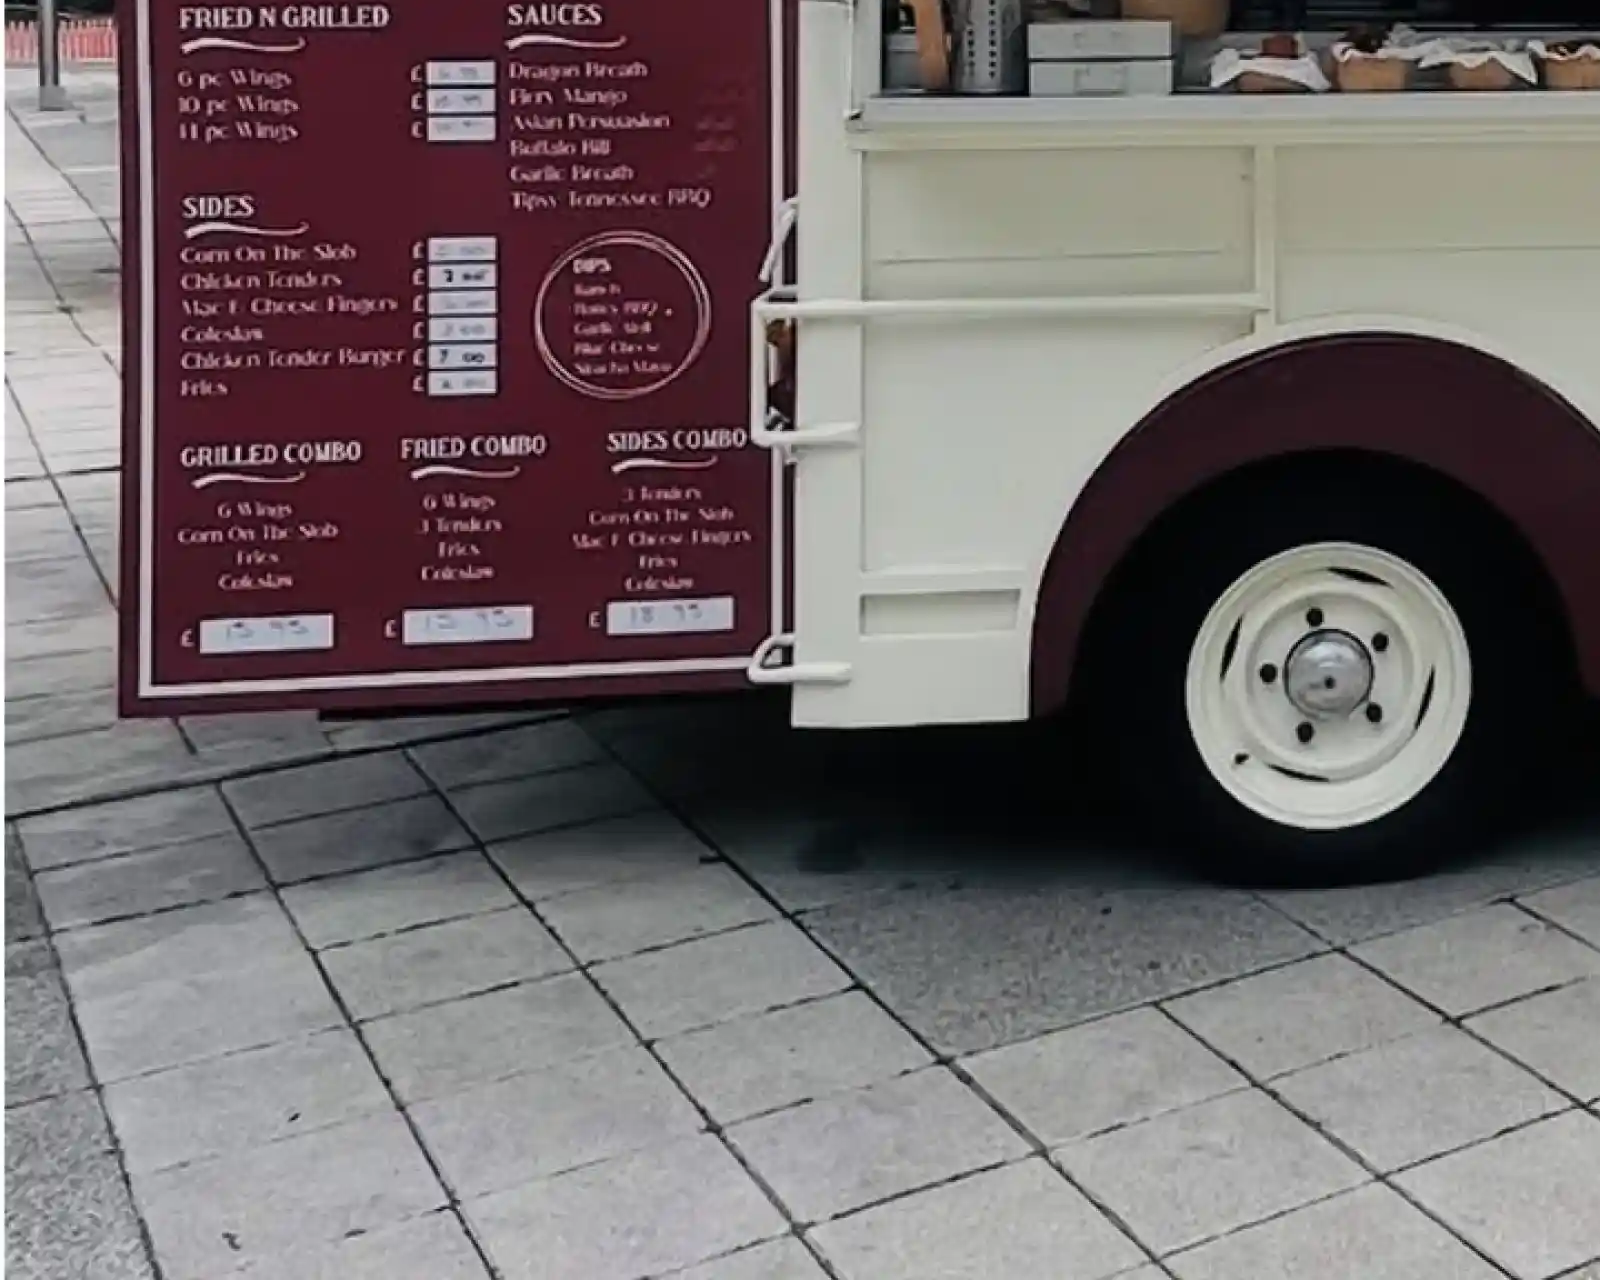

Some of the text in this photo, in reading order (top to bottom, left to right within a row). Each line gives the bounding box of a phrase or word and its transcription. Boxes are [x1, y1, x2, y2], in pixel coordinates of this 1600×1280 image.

[180, 6, 389, 29] FRIED N GRILLED
[509, 4, 602, 25] SAUCES
[231, 69, 291, 89] Wings
[509, 62, 647, 81] Dragon Breath
[238, 96, 298, 114] Wings
[564, 89, 627, 106] Mango
[236, 122, 298, 140] Wings
[572, 166, 633, 180] Breath
[184, 196, 253, 218] SIDES
[180, 248, 229, 262] Corn
[235, 247, 265, 260] On
[275, 246, 301, 260] The
[181, 271, 342, 289] Chicken Tenders
[181, 326, 262, 341] Coleslaw
[182, 349, 404, 369] Chicken Tender Burger
[182, 380, 227, 395] Fries
[402, 436, 545, 458] FRIED COMBO
[608, 428, 747, 451] SIDES COMBO
[181, 442, 360, 466] GRILLED COMBO
[642, 486, 701, 500] Tenders
[238, 502, 291, 518] Wings
[443, 494, 495, 511] Wings
[438, 518, 502, 532] Tenders
[589, 512, 629, 524] Corn
[178, 531, 222, 542] Corn
[228, 527, 254, 540] On
[422, 565, 493, 580] Coleslaw
[218, 574, 292, 589] Coleslaw
[625, 577, 693, 591] Coleslaw
